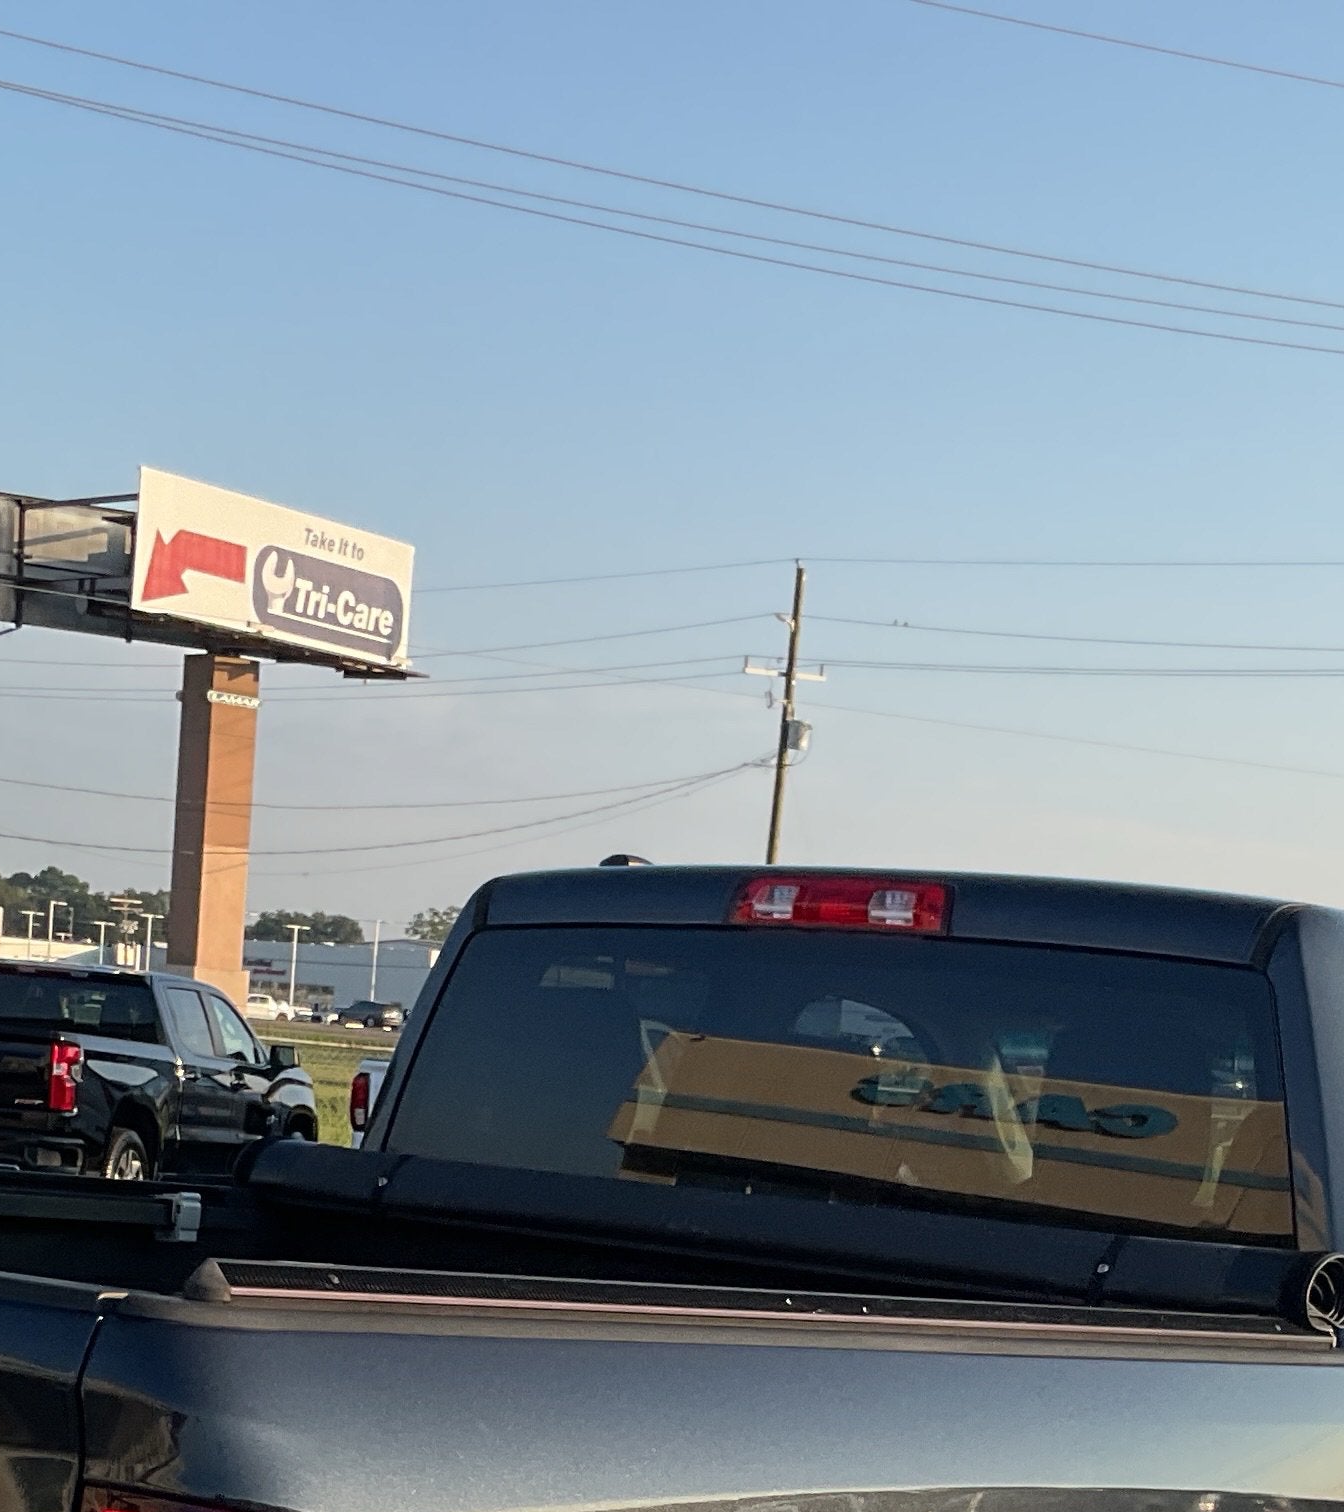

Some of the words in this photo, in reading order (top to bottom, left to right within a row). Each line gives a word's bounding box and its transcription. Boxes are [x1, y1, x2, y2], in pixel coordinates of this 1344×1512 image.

[304, 528, 336, 552] Take
[338, 538, 350, 557] It
[351, 542, 365, 561] to
[295, 577, 394, 636] Tri-Care
